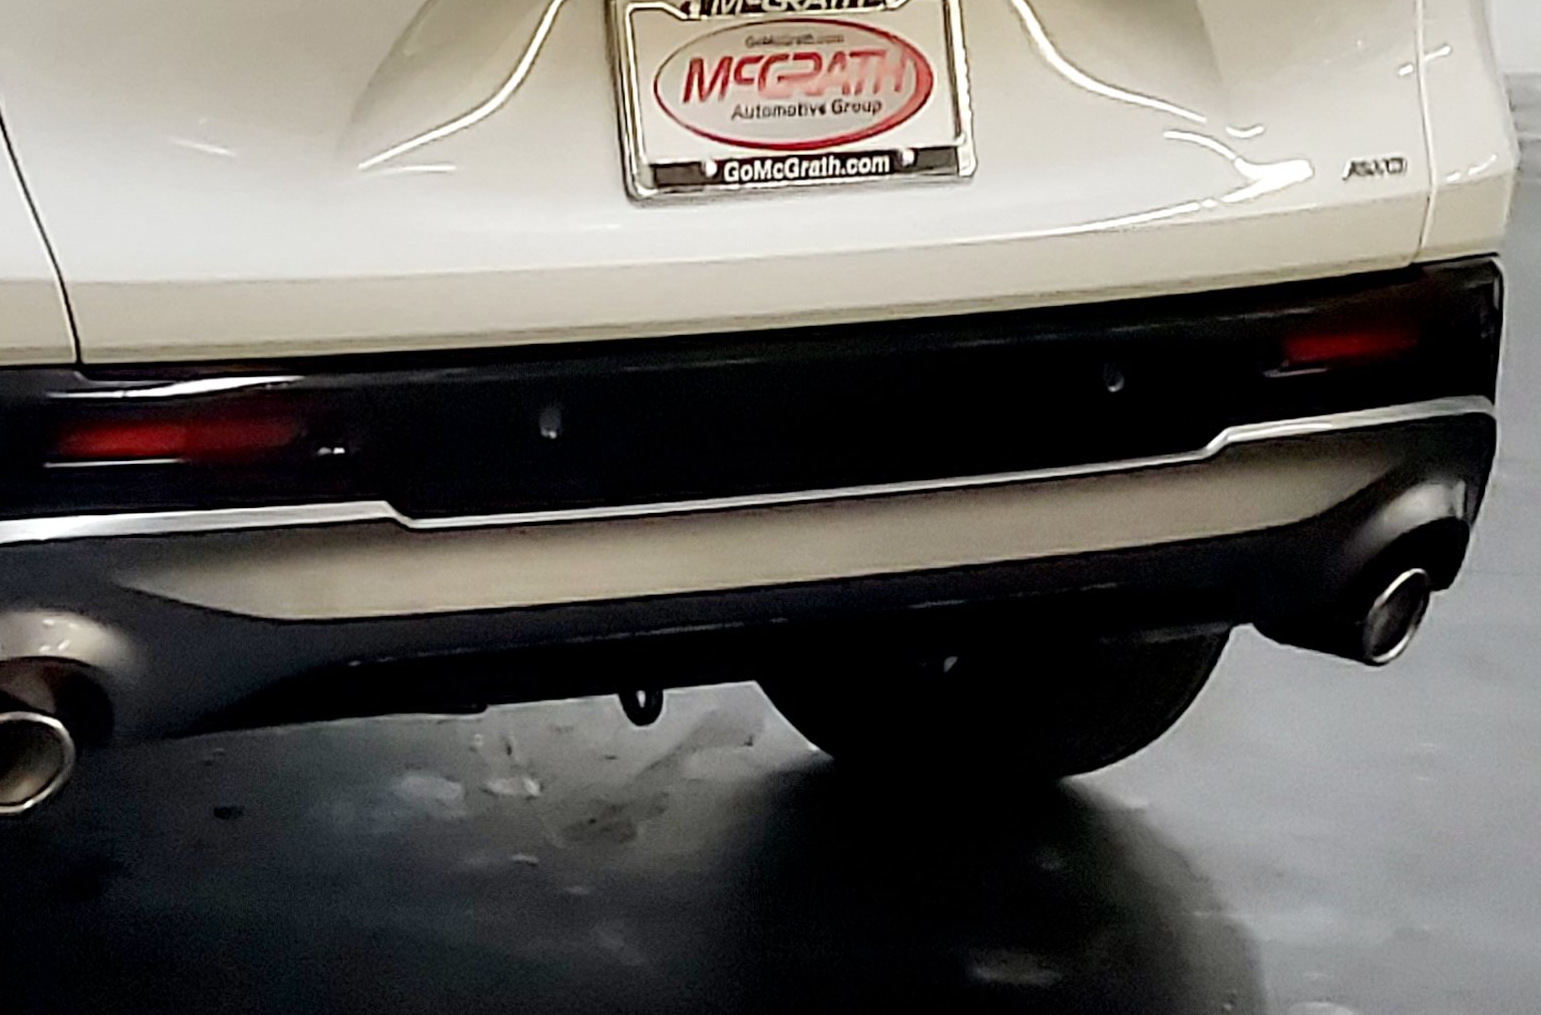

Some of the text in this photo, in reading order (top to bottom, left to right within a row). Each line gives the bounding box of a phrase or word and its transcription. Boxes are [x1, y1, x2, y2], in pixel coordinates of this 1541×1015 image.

[731, 98, 882, 120] Automotive Group
[724, 155, 891, 182] GoMcGrath.com
